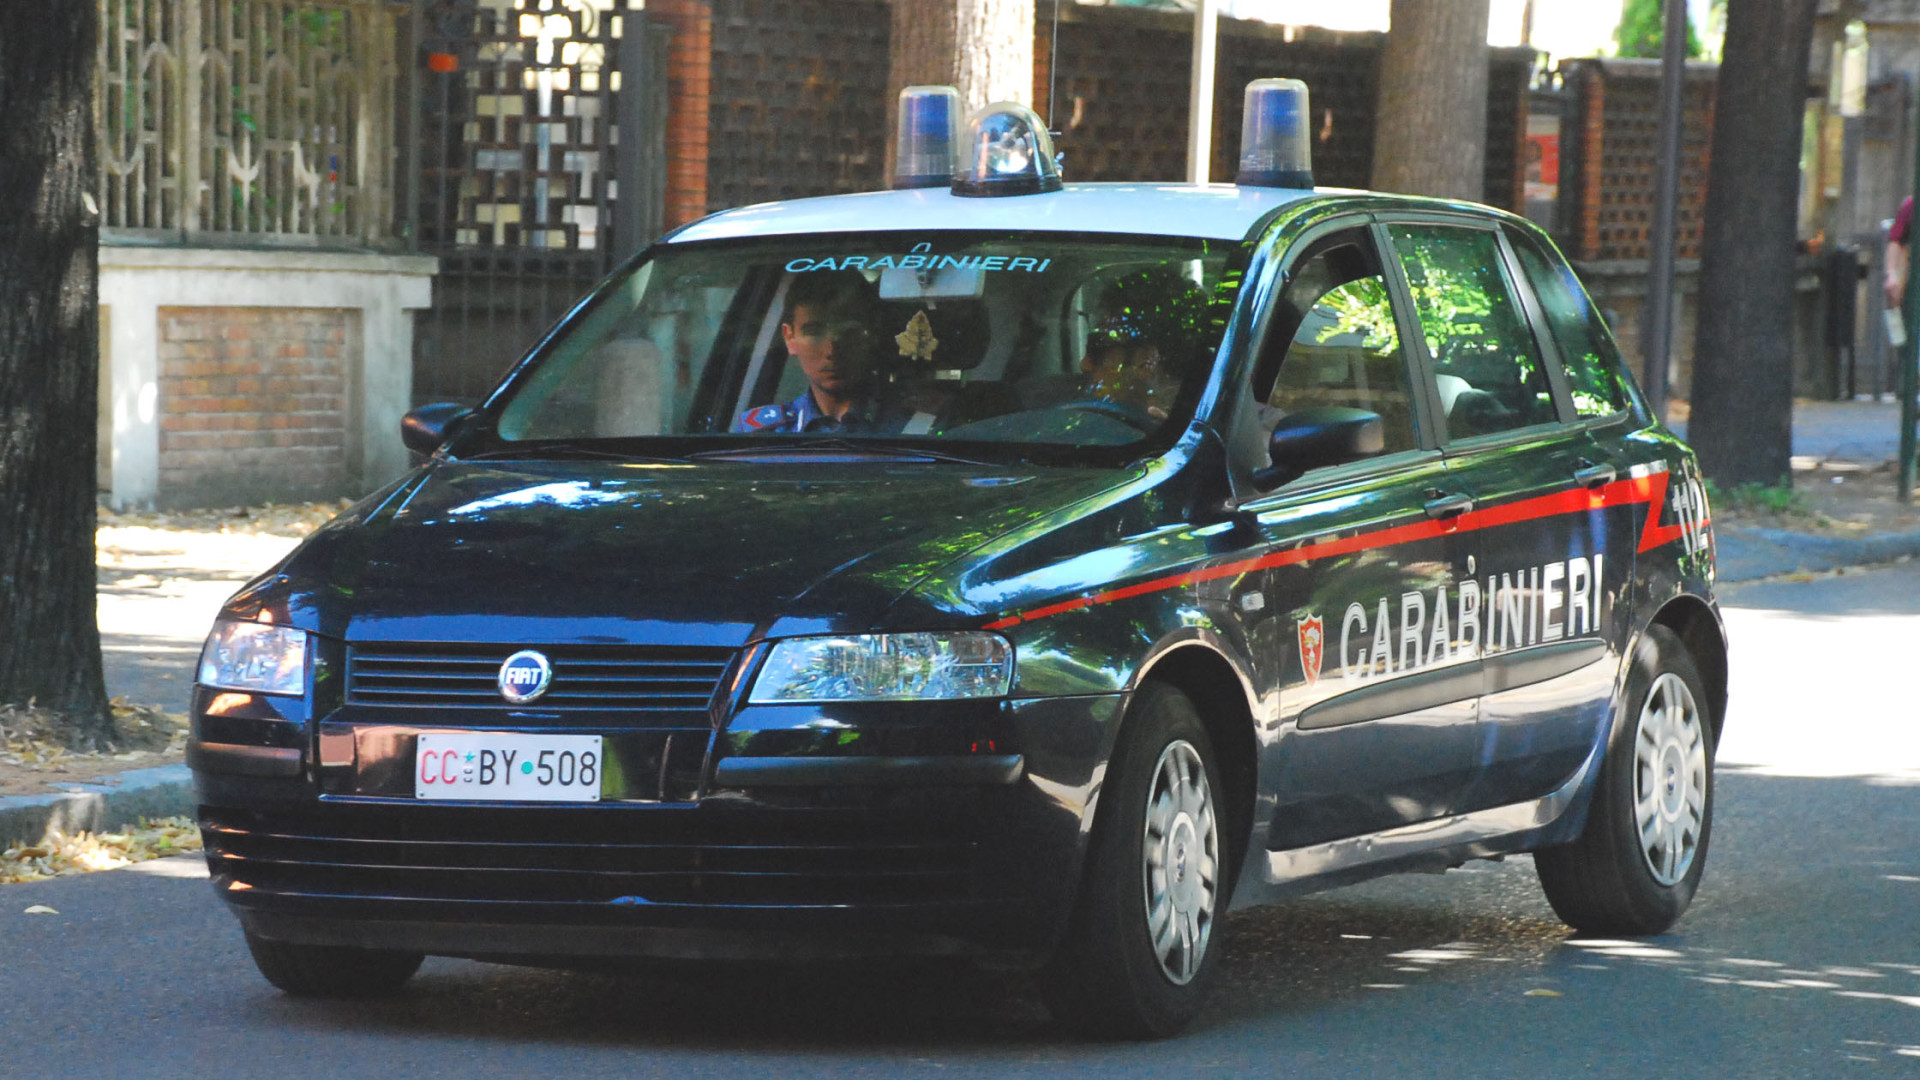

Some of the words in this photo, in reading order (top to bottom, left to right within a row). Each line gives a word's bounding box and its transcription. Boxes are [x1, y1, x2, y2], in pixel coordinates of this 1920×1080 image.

[785, 255, 1051, 272] CARABINIERI
[1672, 477, 1708, 555] 112
[1340, 554, 1603, 678] CARABINIERI
[506, 667, 541, 684] FIAT
[421, 750, 458, 784] CC
[479, 750, 517, 785] BY
[537, 750, 597, 786] 508
